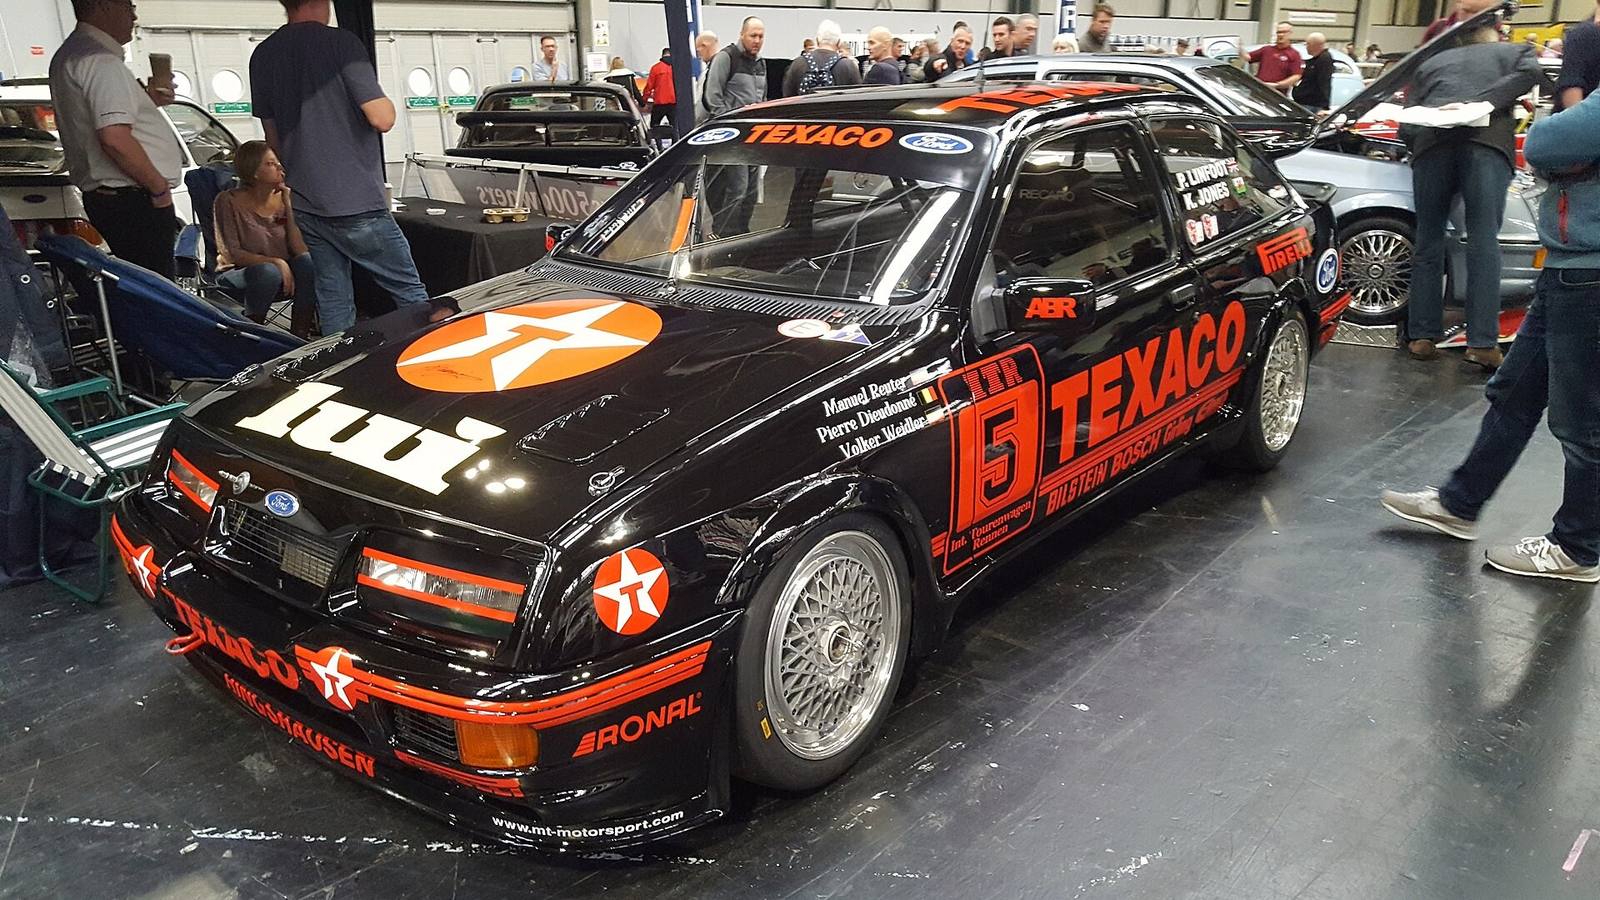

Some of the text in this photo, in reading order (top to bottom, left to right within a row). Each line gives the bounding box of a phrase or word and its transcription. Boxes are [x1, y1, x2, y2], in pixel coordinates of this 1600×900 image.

[744, 124, 894, 148] TEXACO
[1018, 188, 1075, 201] RECARO
[1182, 181, 1230, 210] K. JONES
[1024, 296, 1077, 319] ABR
[822, 376, 908, 417] Manuel Reuter
[1051, 300, 1246, 464] TEXACO
[234, 382, 507, 495] lui
[816, 392, 918, 443] Pierre Dieudonné
[839, 414, 928, 459] Volker Weidler
[981, 400, 1019, 508] 5
[1046, 460, 1108, 516] BILSTEIN
[1110, 429, 1161, 478] BOSCH
[950, 501, 1031, 553] Int. Tourenwagen
[972, 524, 1008, 550] Rennen
[161, 586, 299, 690] TEXACO
[597, 694, 701, 751] RONAL
[492, 808, 684, 838] www.mt-motorsport.com
